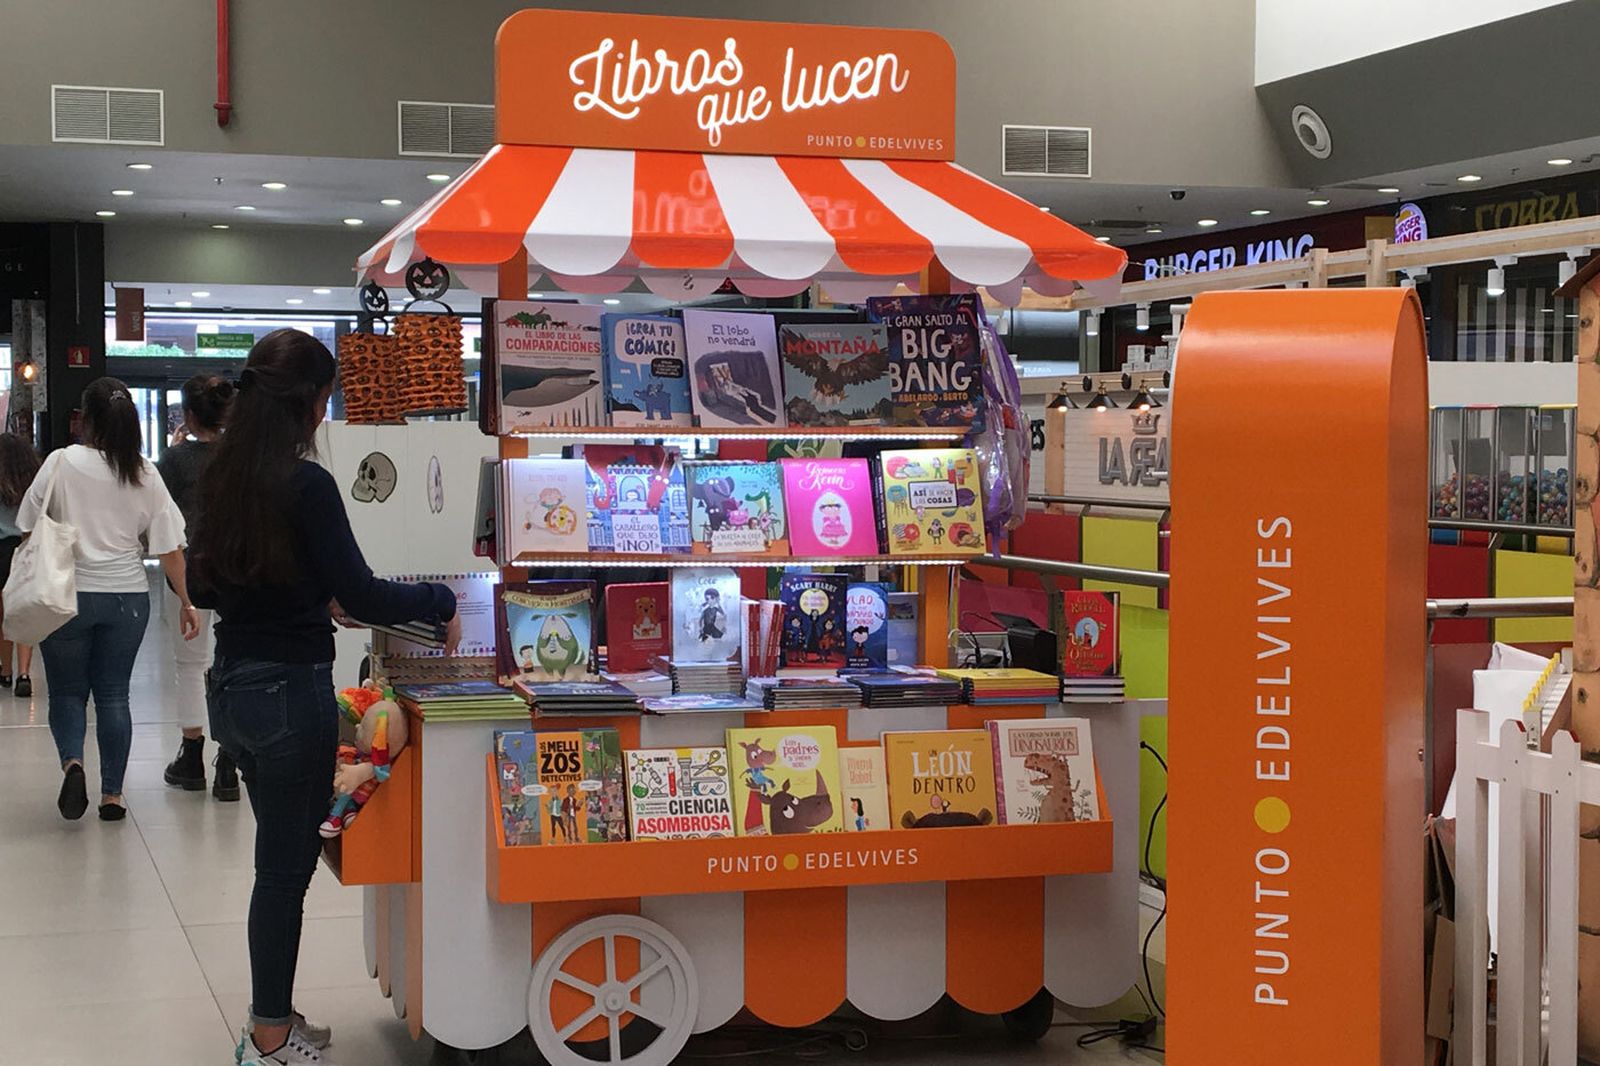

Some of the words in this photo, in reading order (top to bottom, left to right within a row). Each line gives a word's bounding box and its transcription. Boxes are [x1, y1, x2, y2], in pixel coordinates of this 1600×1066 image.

[569, 38, 743, 119] Libros
[698, 86, 772, 146] que
[782, 47, 910, 112] lucen
[807, 134, 853, 148] PUNTO
[869, 136, 944, 150] EDELVIVES
[1144, 245, 1237, 281] BURGER
[895, 314, 922, 328] GRAN
[925, 313, 953, 326] SALTO
[956, 312, 968, 325] AL
[525, 330, 532, 338] EL
[557, 332, 566, 340] DE
[569, 332, 582, 341] LAS
[659, 324, 673, 338] TU
[712, 324, 724, 335] El
[727, 325, 750, 336] lobo
[506, 337, 601, 354] COMPARACIONES
[624, 336, 676, 356] CÓMIC!
[707, 336, 720, 346] no
[721, 335, 756, 347] vendrá
[785, 335, 881, 355] MONTAÑA
[901, 328, 952, 360] BIG
[889, 361, 972, 392] BANG
[913, 487, 927, 497] ASÍ
[926, 496, 953, 504] COSAS
[616, 531, 635, 539] QUE
[790, 581, 813, 593] SCARY
[814, 581, 838, 594] HARRY
[1256, 516, 1293, 781] EDELVIVES
[547, 740, 578, 753] MELLI
[782, 741, 820, 759] padres
[540, 752, 581, 774] ZOS
[911, 743, 974, 777] LEÓN
[541, 773, 582, 783] DETECTIVES
[913, 776, 976, 795] DENTRO
[668, 797, 730, 816] CIENCIA
[636, 814, 732, 835] ASOMBROSA
[707, 855, 778, 874] PUNTO
[805, 848, 919, 870] EDELVIVES
[1254, 848, 1290, 1006] PUNTO
